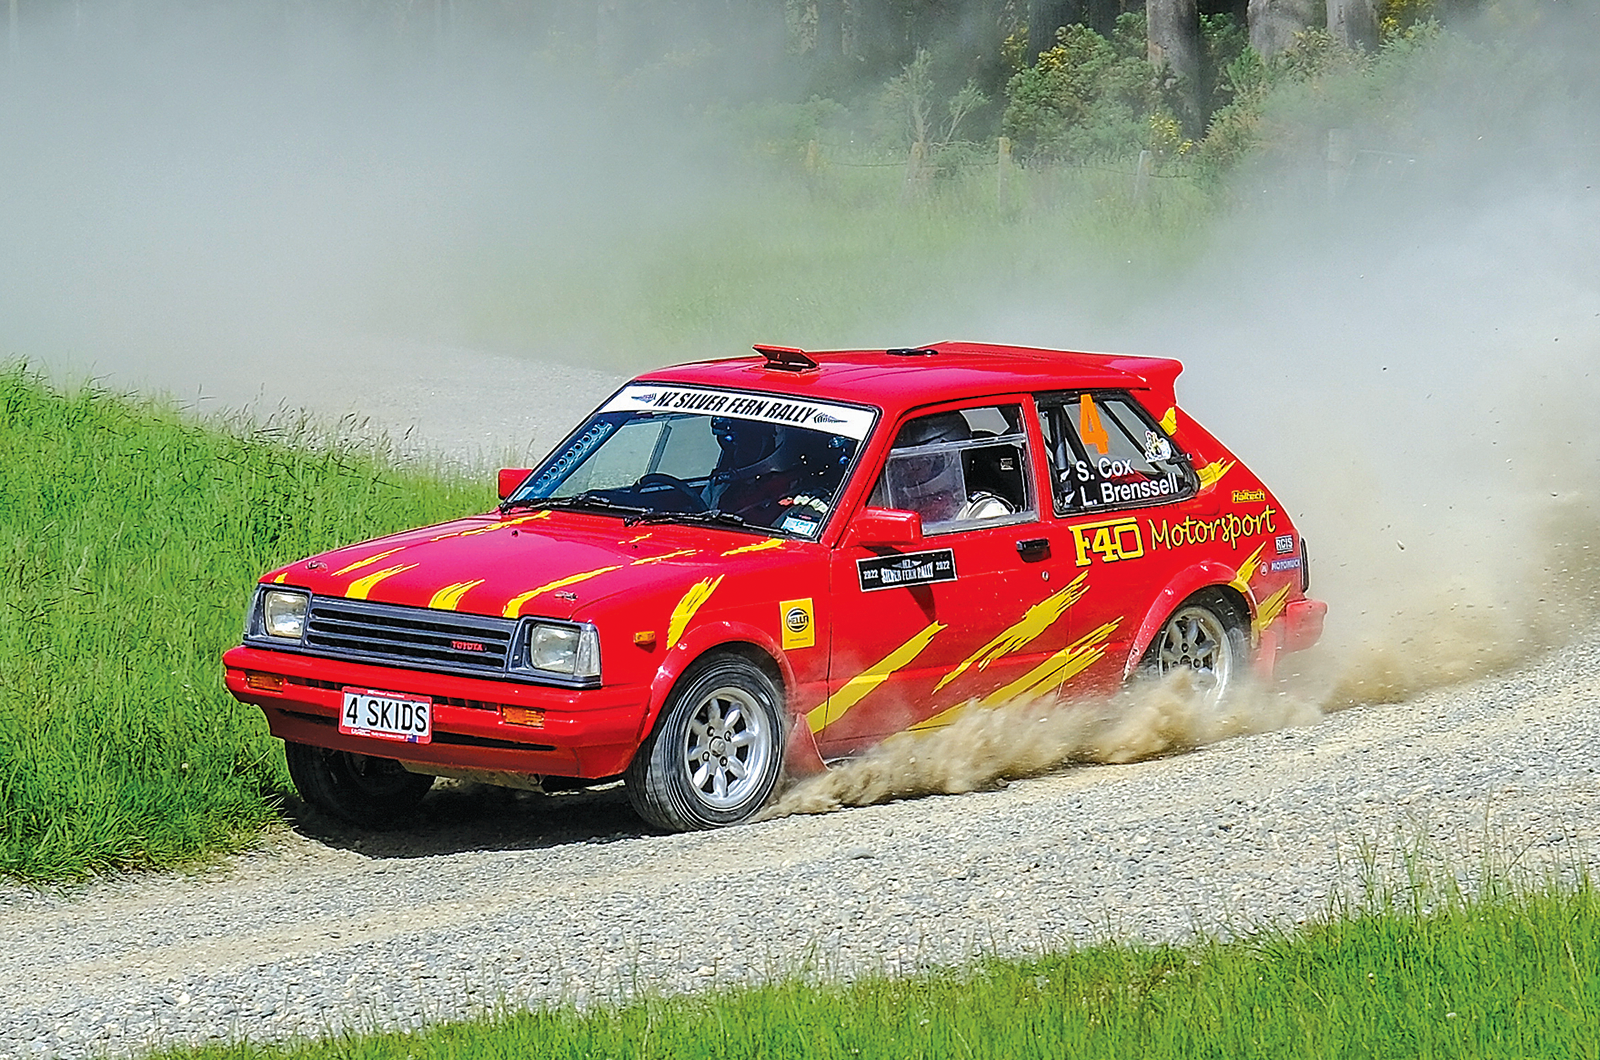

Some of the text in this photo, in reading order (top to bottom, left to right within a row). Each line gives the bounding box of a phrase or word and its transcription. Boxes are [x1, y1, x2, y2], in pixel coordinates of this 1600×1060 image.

[653, 392, 818, 423] NZ SILVER FERN RALLY
[1080, 394, 1108, 454] 4
[1076, 460, 1096, 482] S.
[1098, 457, 1135, 478] Cox
[1080, 473, 1179, 507] L. Brenssell
[1068, 504, 1276, 567] F40 Motorsport
[863, 570, 879, 579] 2022
[451, 641, 483, 651] TOYOTA
[346, 697, 427, 732] 4 SKIDS
